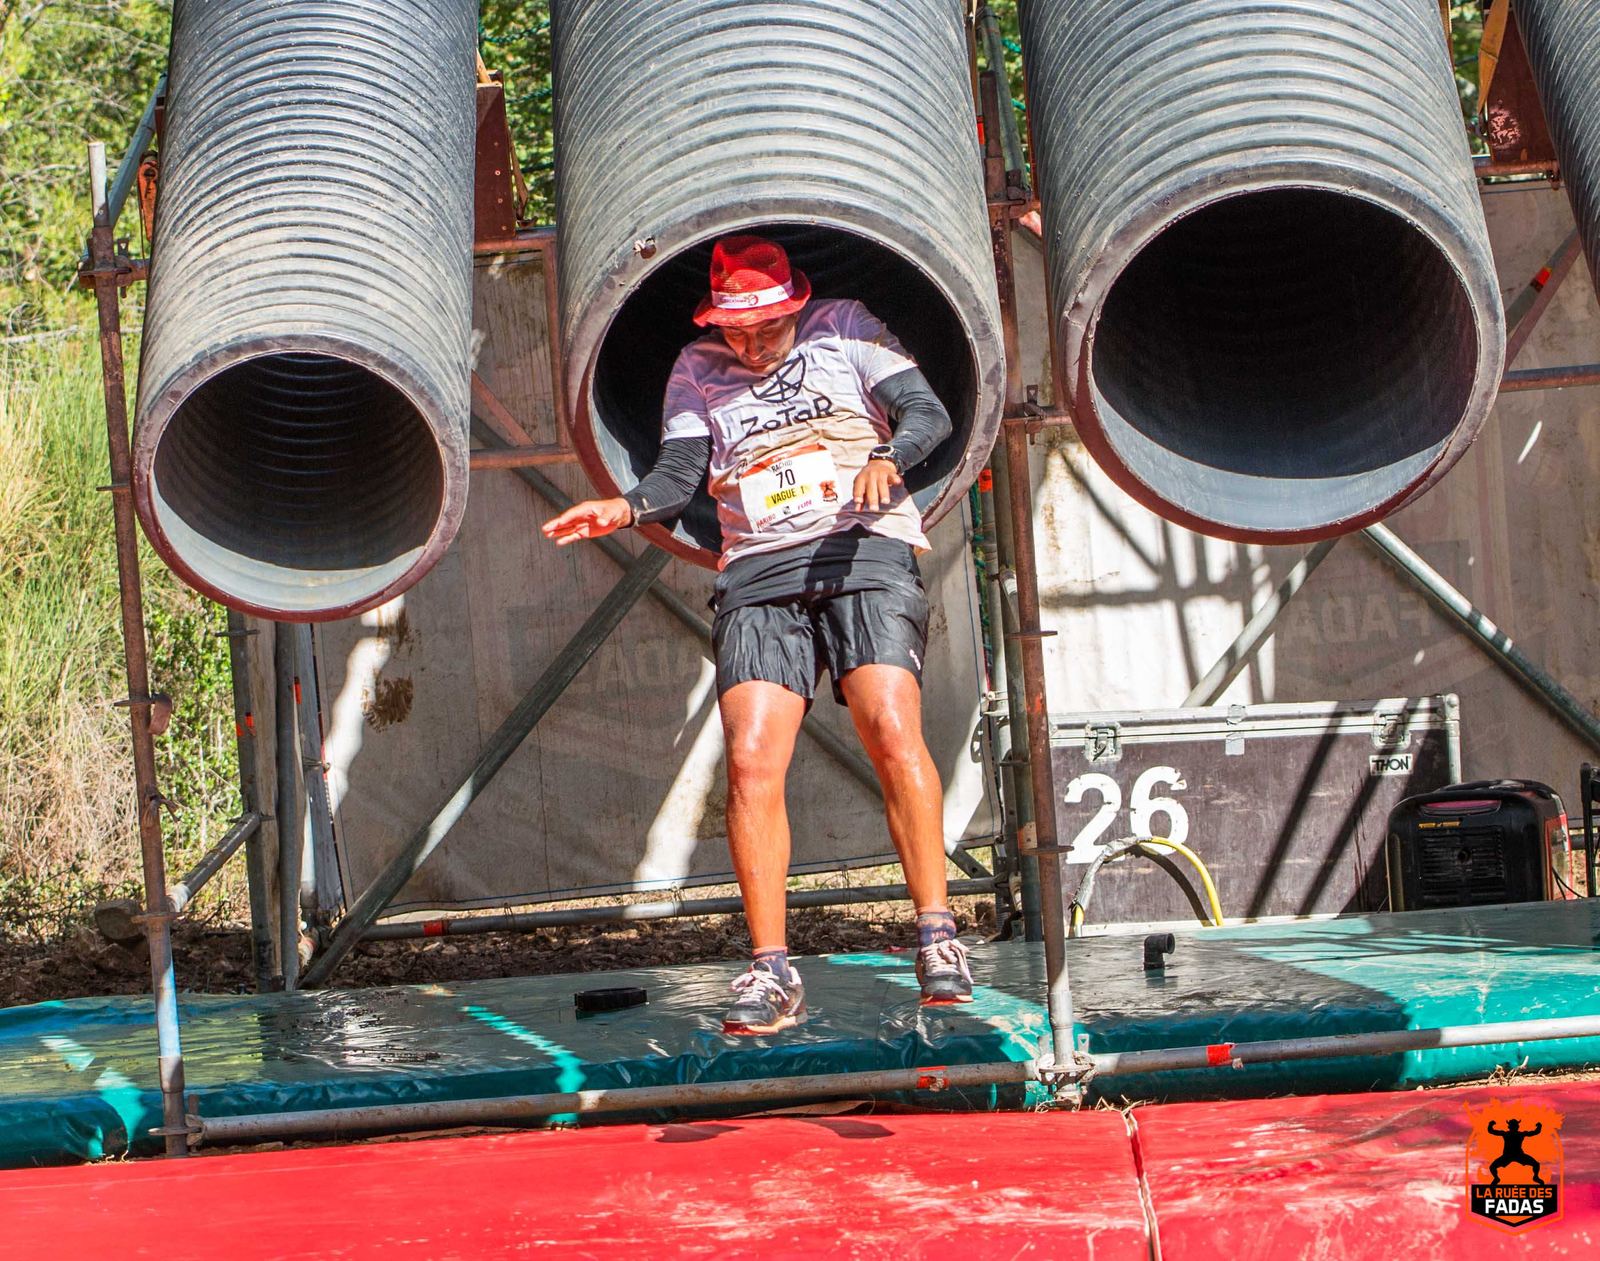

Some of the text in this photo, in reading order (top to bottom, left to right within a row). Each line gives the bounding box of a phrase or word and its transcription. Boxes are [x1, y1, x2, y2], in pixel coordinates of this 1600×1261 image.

[776, 469, 796, 489] 70
[771, 488, 796, 505] VAGUE
[800, 485, 805, 494] 1
[1372, 756, 1409, 771] THON
[1064, 765, 1189, 865] 26
